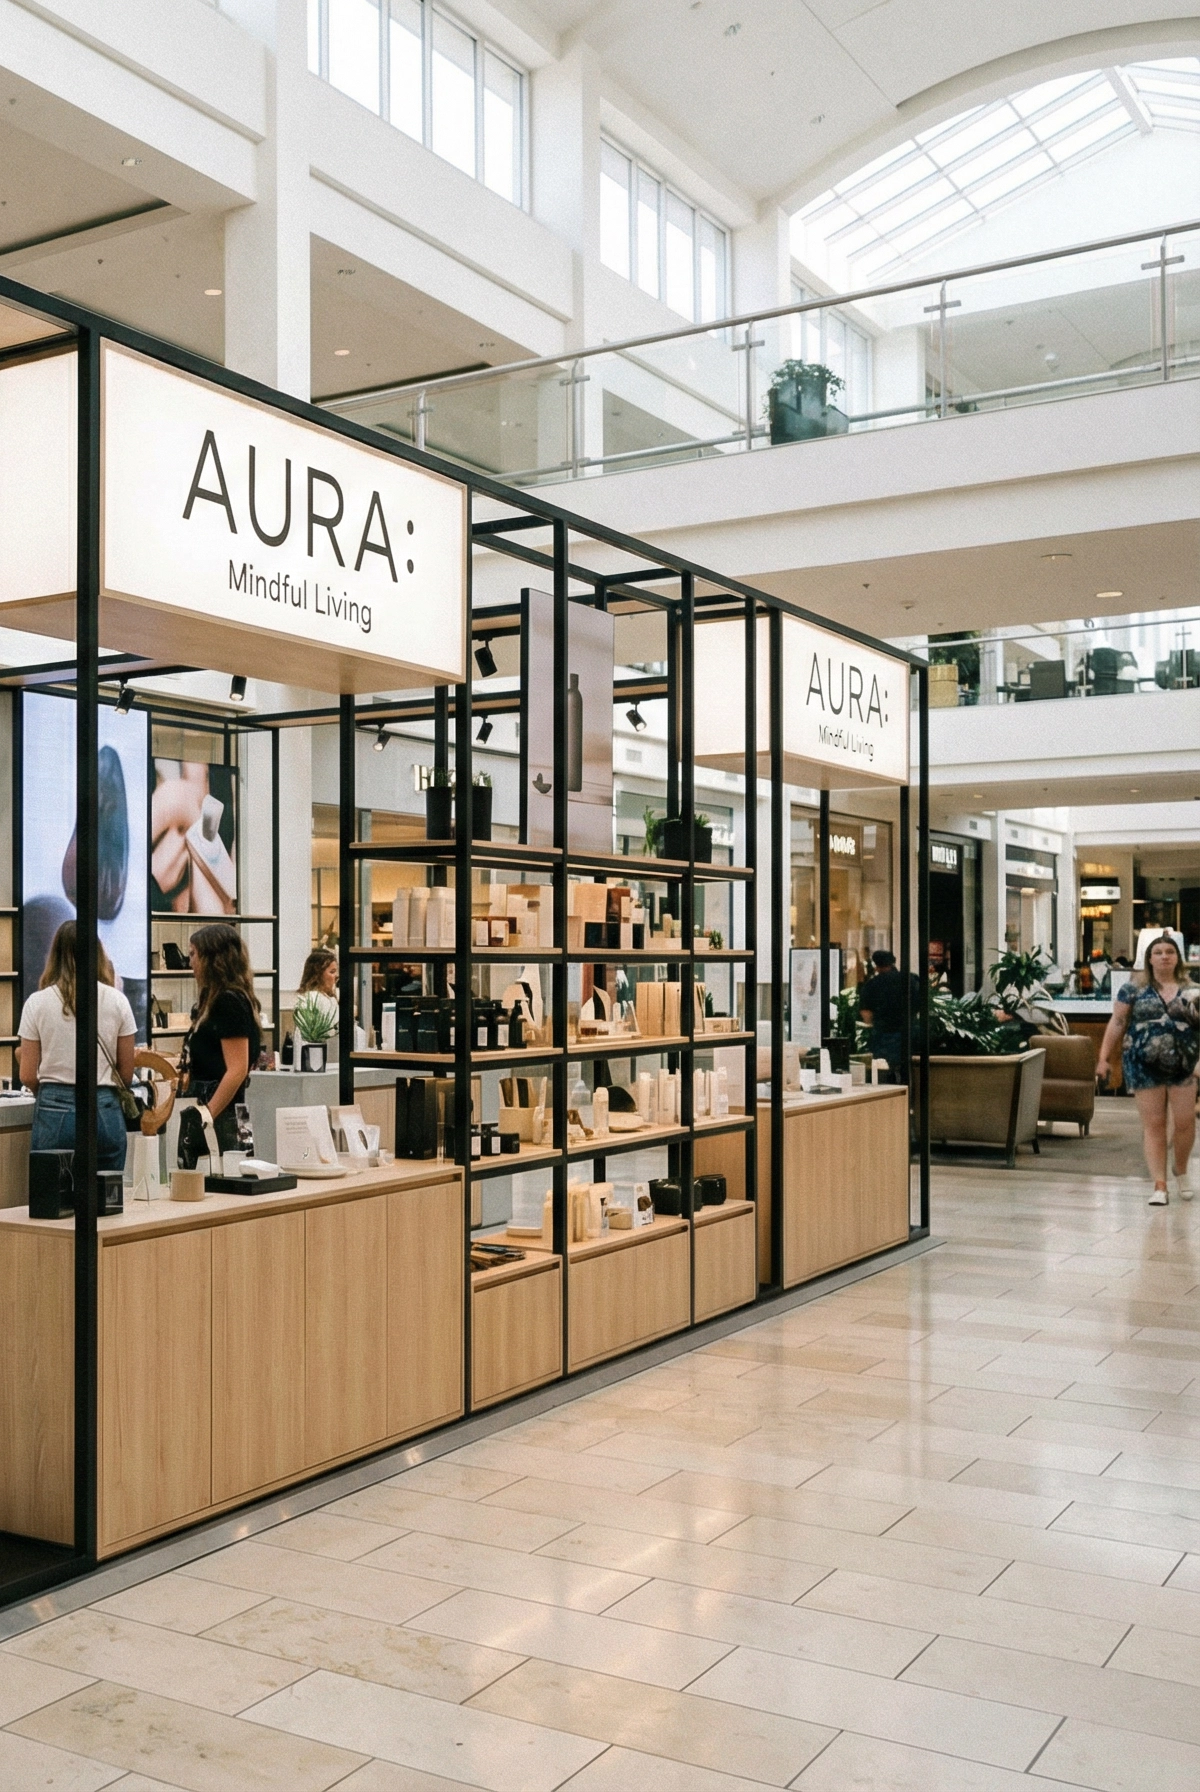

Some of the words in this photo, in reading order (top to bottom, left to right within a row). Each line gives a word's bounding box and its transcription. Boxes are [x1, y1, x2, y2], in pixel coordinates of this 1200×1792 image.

[182, 429, 415, 583] AURA:
[228, 559, 307, 610] Mindful
[315, 583, 372, 634] Living
[805, 652, 889, 729] AURA:
